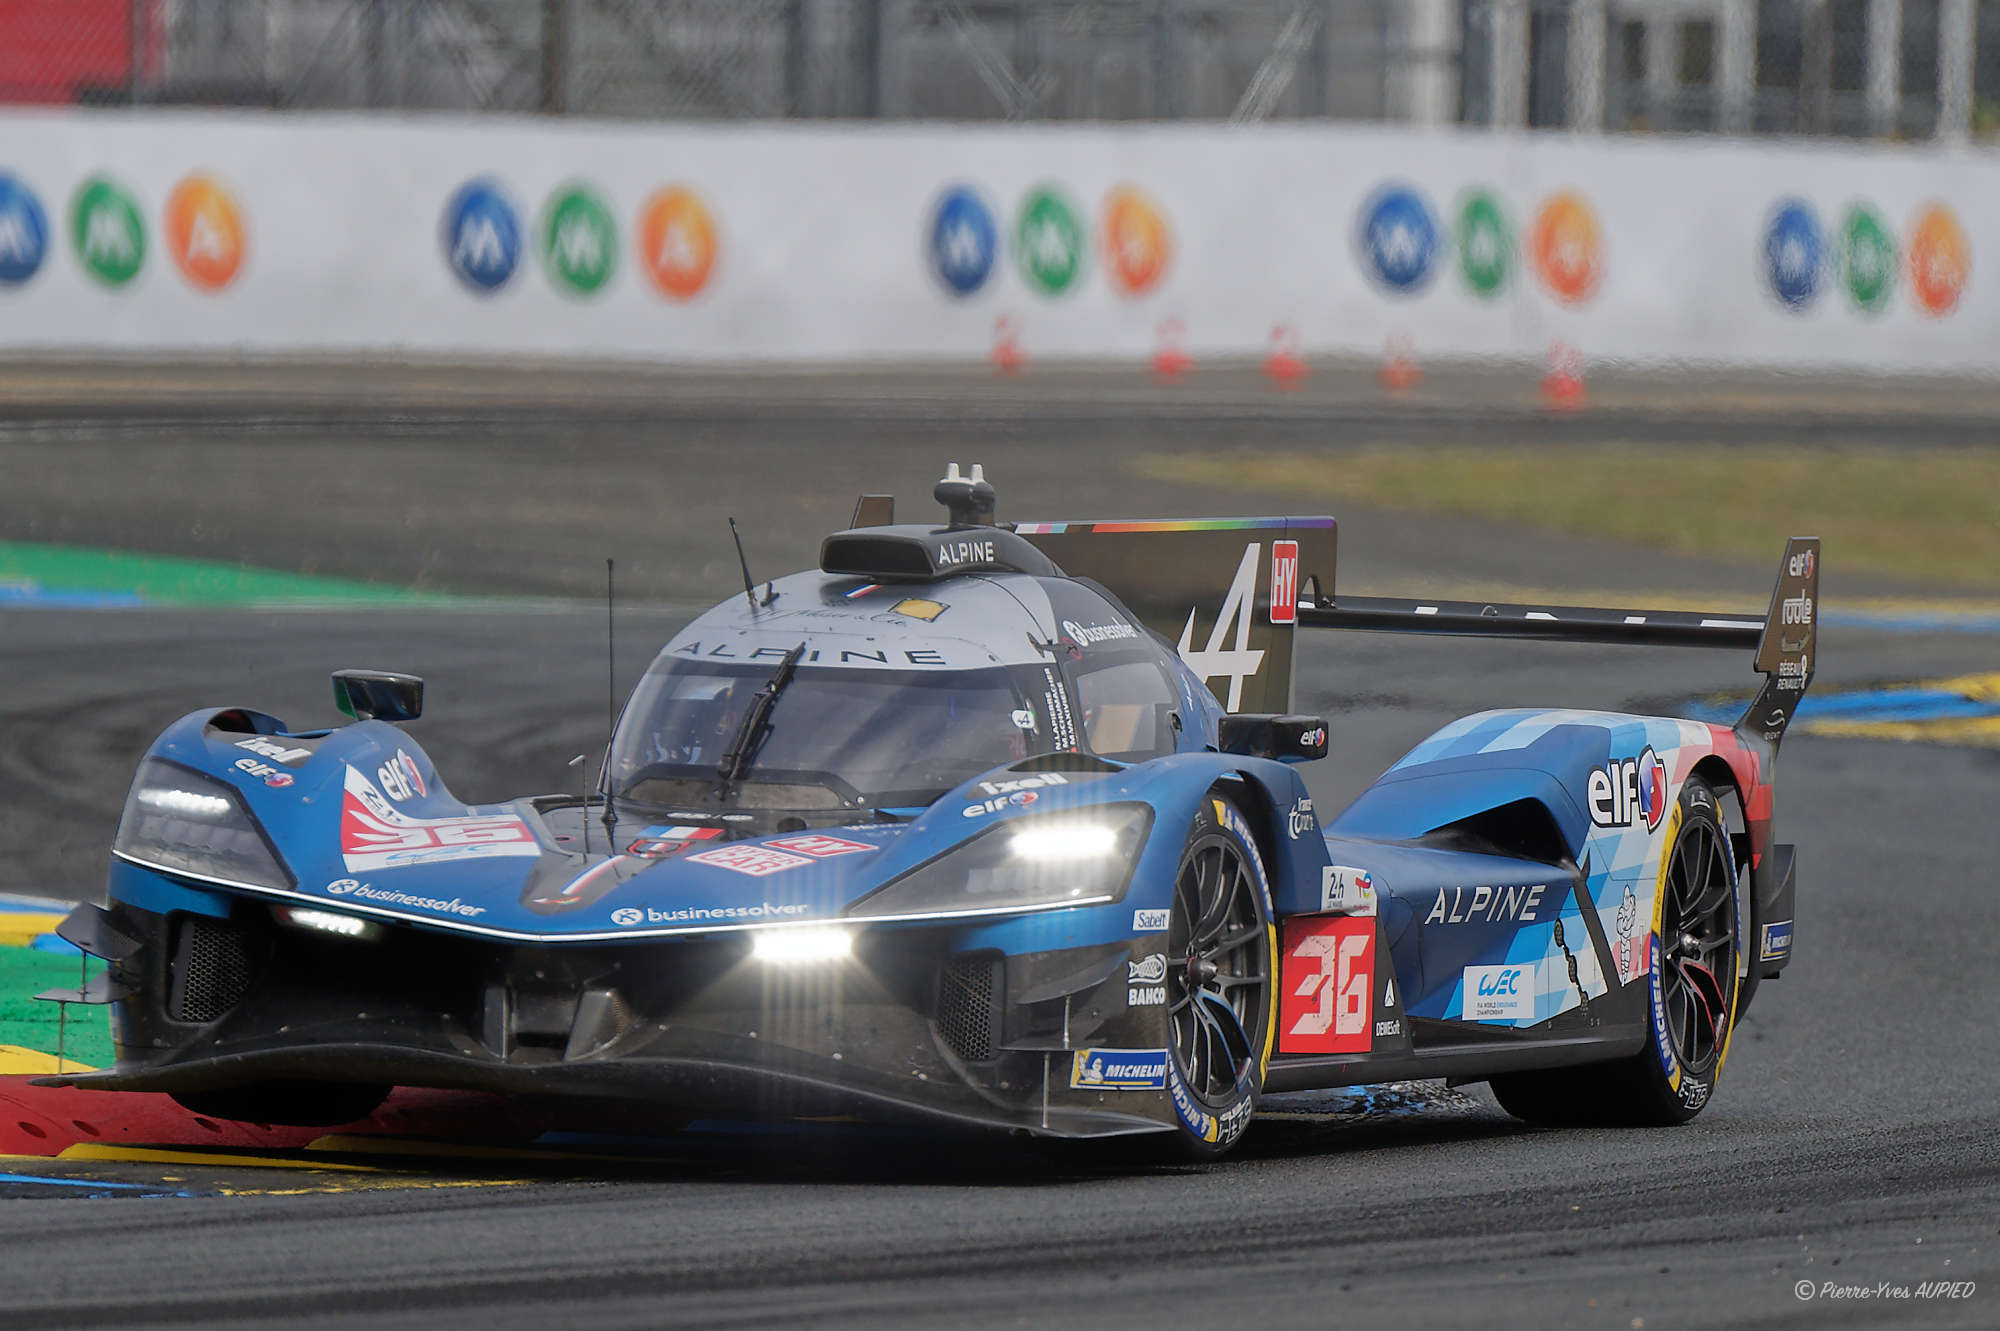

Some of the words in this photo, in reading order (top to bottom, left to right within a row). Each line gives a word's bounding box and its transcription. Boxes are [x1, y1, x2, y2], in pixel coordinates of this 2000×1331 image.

[938, 541, 995, 565] ALPINE
[1789, 552, 1805, 577] elf
[1272, 557, 1296, 607] HY
[673, 640, 947, 665] ALPINE
[1300, 730, 1317, 746] elf
[234, 758, 278, 777] elf
[377, 757, 413, 802] elf
[1588, 758, 1640, 828] elf
[962, 796, 1009, 818] elf
[353, 882, 487, 917] businessolver
[647, 902, 810, 922] businessolver
[1424, 884, 1547, 925] ALPINE
[1137, 911, 1168, 929] Sabelt
[1288, 935, 1371, 1035] 36
[1478, 969, 1521, 997] WEC
[1128, 986, 1166, 1007] BAHCO
[1651, 945, 1673, 1060] MICHELIN
[1104, 1064, 1166, 1078] MICHELIN
